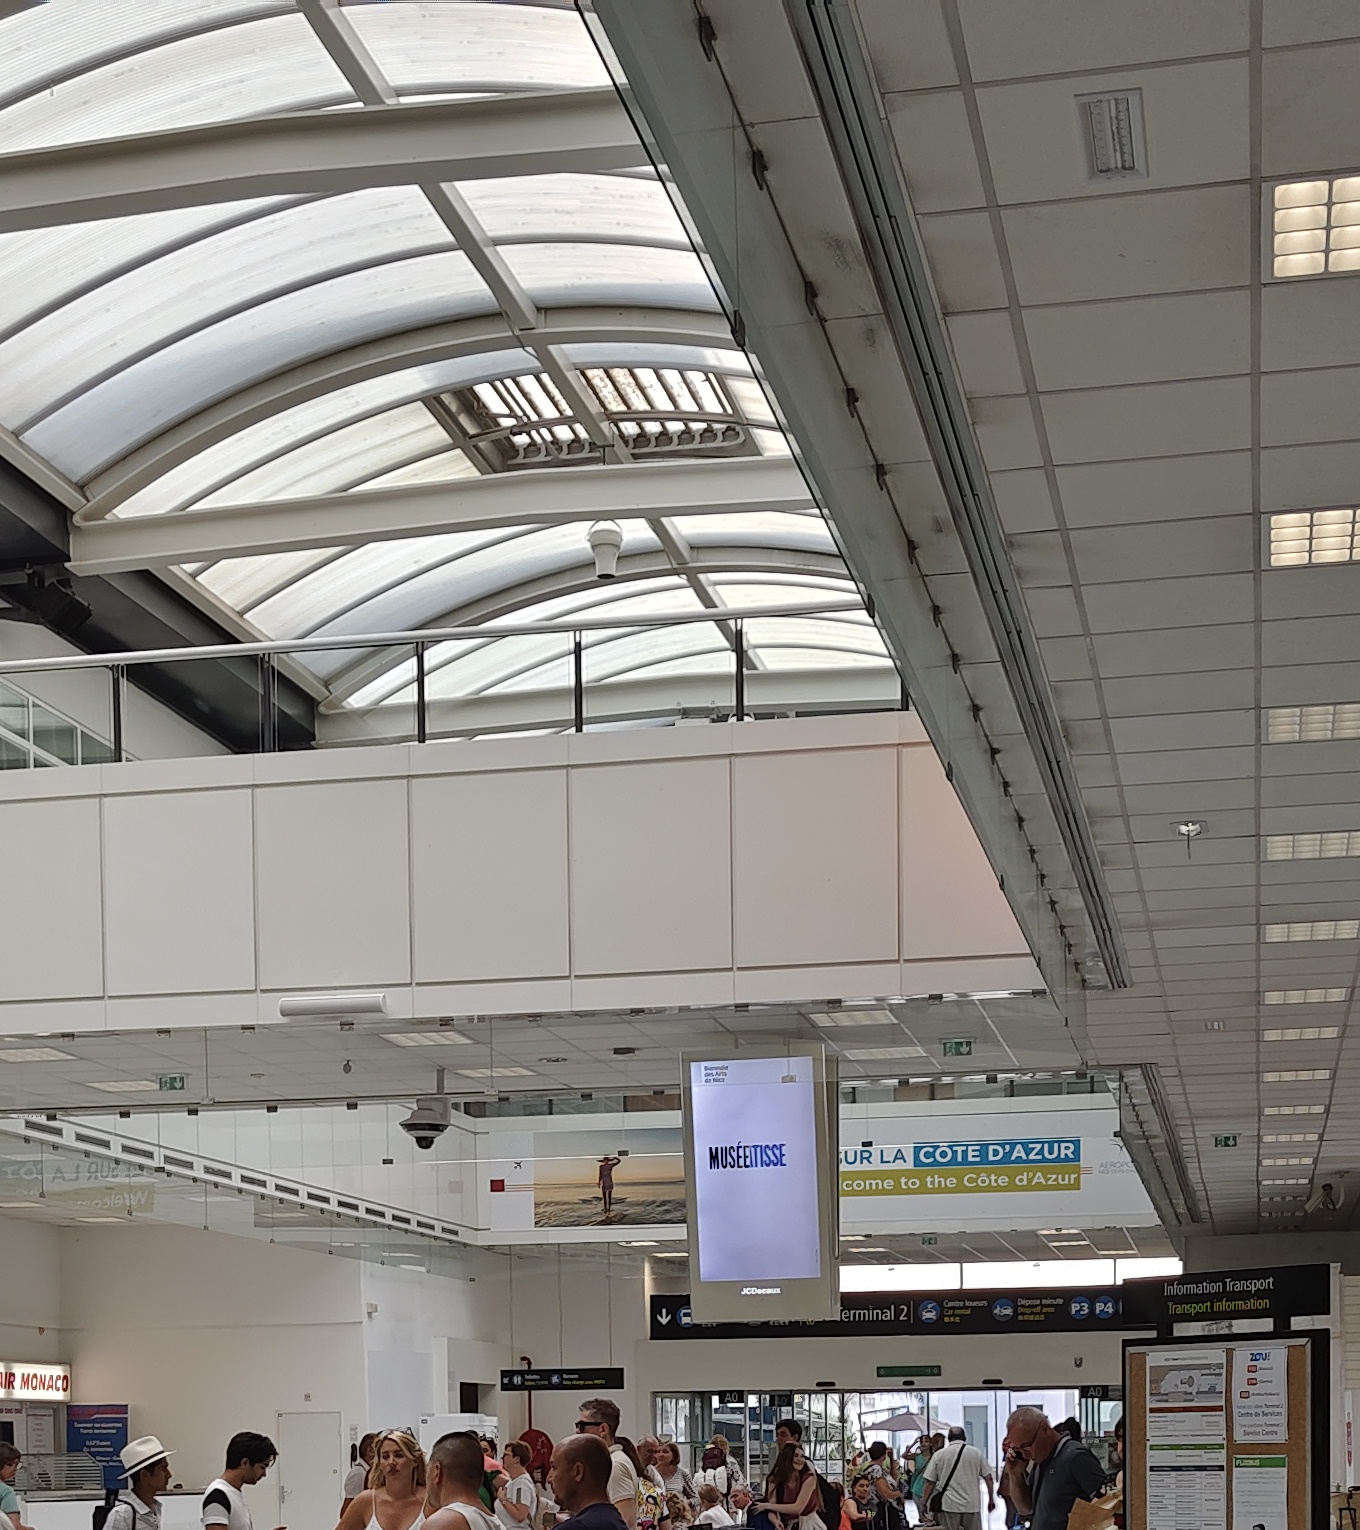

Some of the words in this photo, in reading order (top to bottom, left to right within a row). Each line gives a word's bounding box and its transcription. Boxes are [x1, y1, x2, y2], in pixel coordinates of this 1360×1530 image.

[880, 1148, 908, 1164] LA
[918, 1141, 981, 1164] CÔTE
[900, 1174, 920, 1188] to
[926, 1174, 957, 1188] the
[963, 1170, 1009, 1187] Côte
[740, 1286, 782, 1295] JCDecaux
[1163, 1278, 1224, 1297] Information
[1224, 1275, 1275, 1294] Transport
[898, 1304, 909, 1321] 2
[1070, 1302, 1089, 1315] P3
[1095, 1301, 1114, 1314] P4
[1167, 1301, 1212, 1316] Transport
[1213, 1298, 1270, 1312] information
[19, 1372, 69, 1393] MONACO
